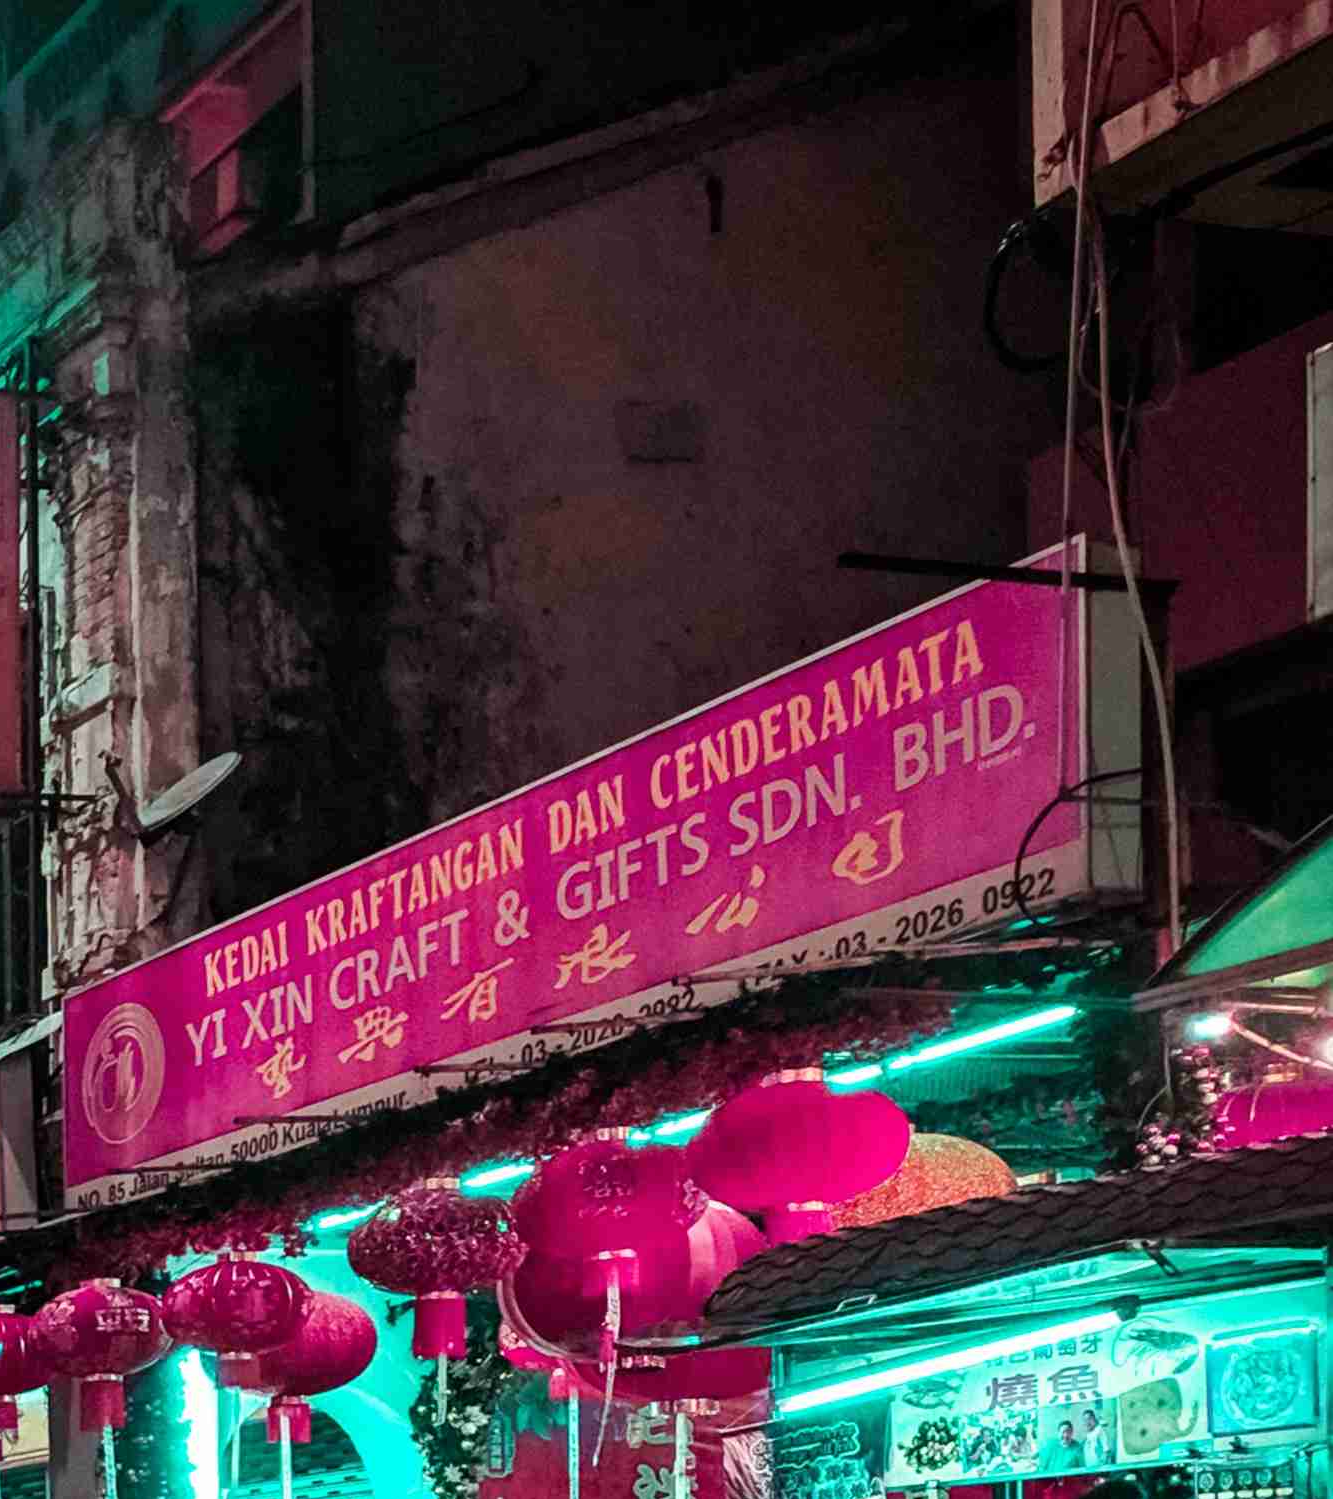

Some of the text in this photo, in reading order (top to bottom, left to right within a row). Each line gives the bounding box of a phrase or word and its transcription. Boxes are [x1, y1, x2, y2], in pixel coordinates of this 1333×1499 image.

[205, 618, 985, 998] KEDAI KRAFTANGAN DAN CENDERAMATA
[184, 684, 1036, 1067] YI XIN CRAFT & GIFTS SDN. BHD.
[836, 932, 868, 959] 03
[895, 898, 964, 945] 2026
[982, 867, 1056, 914] 0922
[108, 1182, 126, 1202] 85
[230, 1132, 279, 1163] 50000
[985, 1365, 1103, 1410] 燒魚
